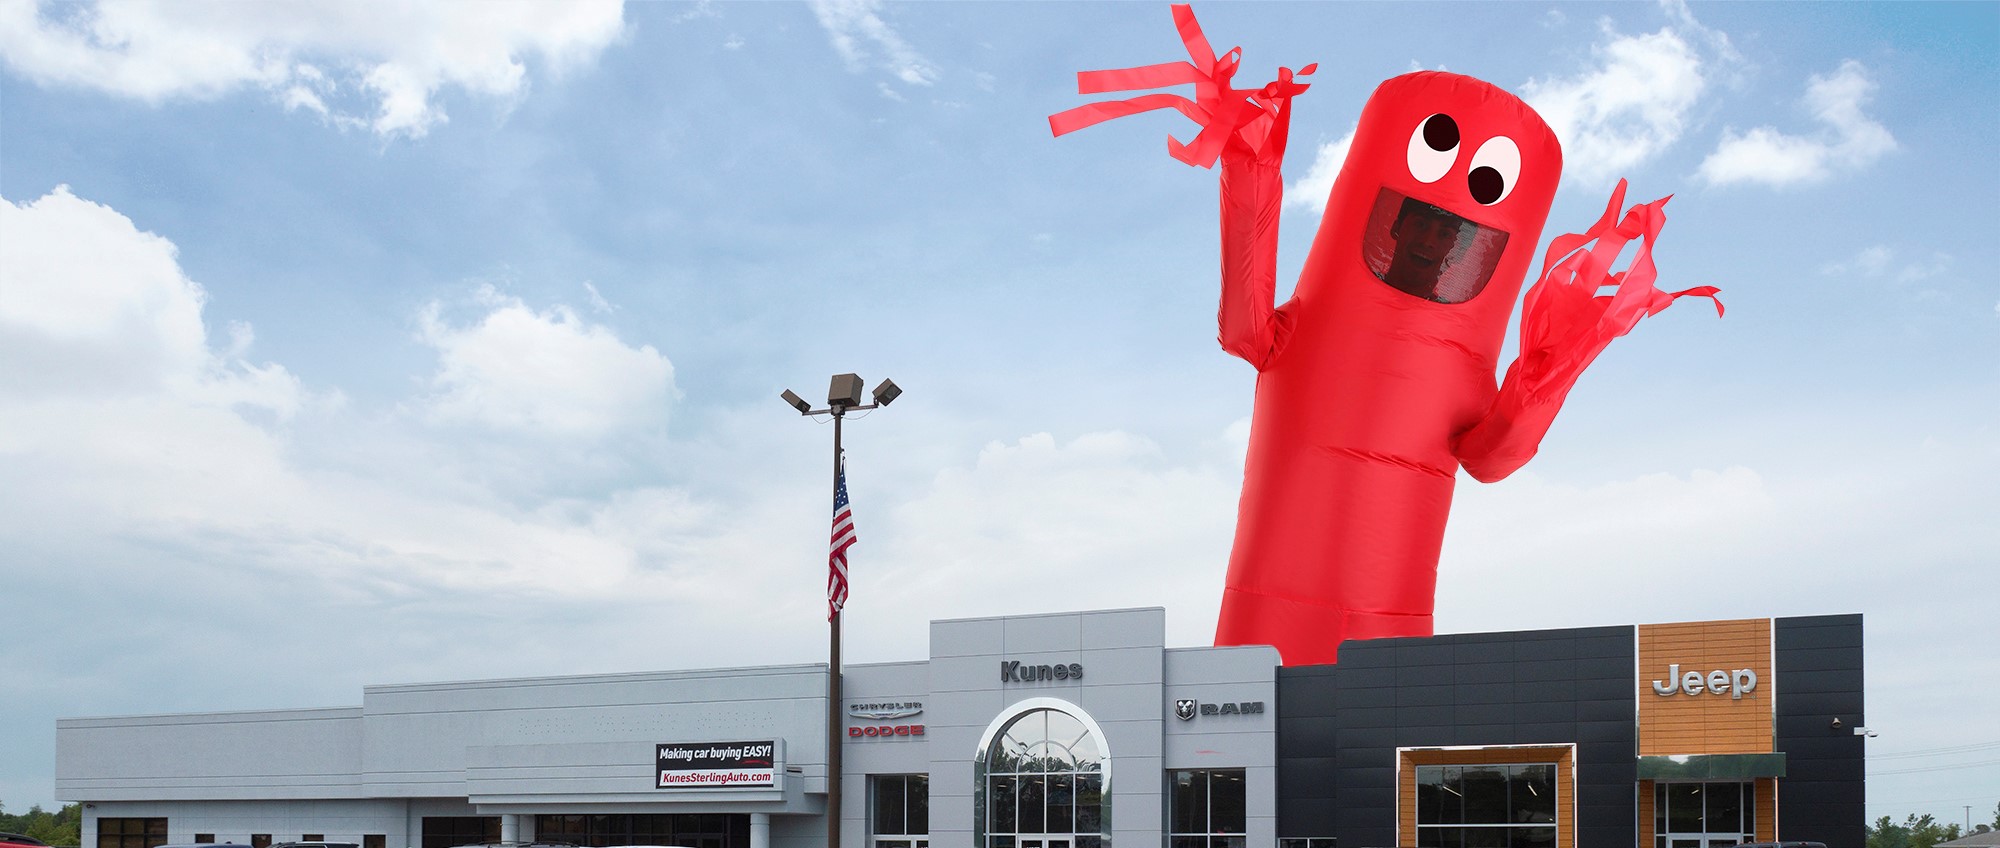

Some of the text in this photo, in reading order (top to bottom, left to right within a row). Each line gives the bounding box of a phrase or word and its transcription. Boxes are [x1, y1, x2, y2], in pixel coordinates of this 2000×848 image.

[1001, 660, 1083, 682] Kunes
[1652, 664, 1757, 700] Jeep
[850, 702, 922, 710] CHRYSLER
[1201, 702, 1264, 715] RAM
[848, 724, 925, 737] DODGE
[660, 745, 771, 761] Making car buying EASY!
[663, 772, 771, 784] KunesSterlingAuto.com
